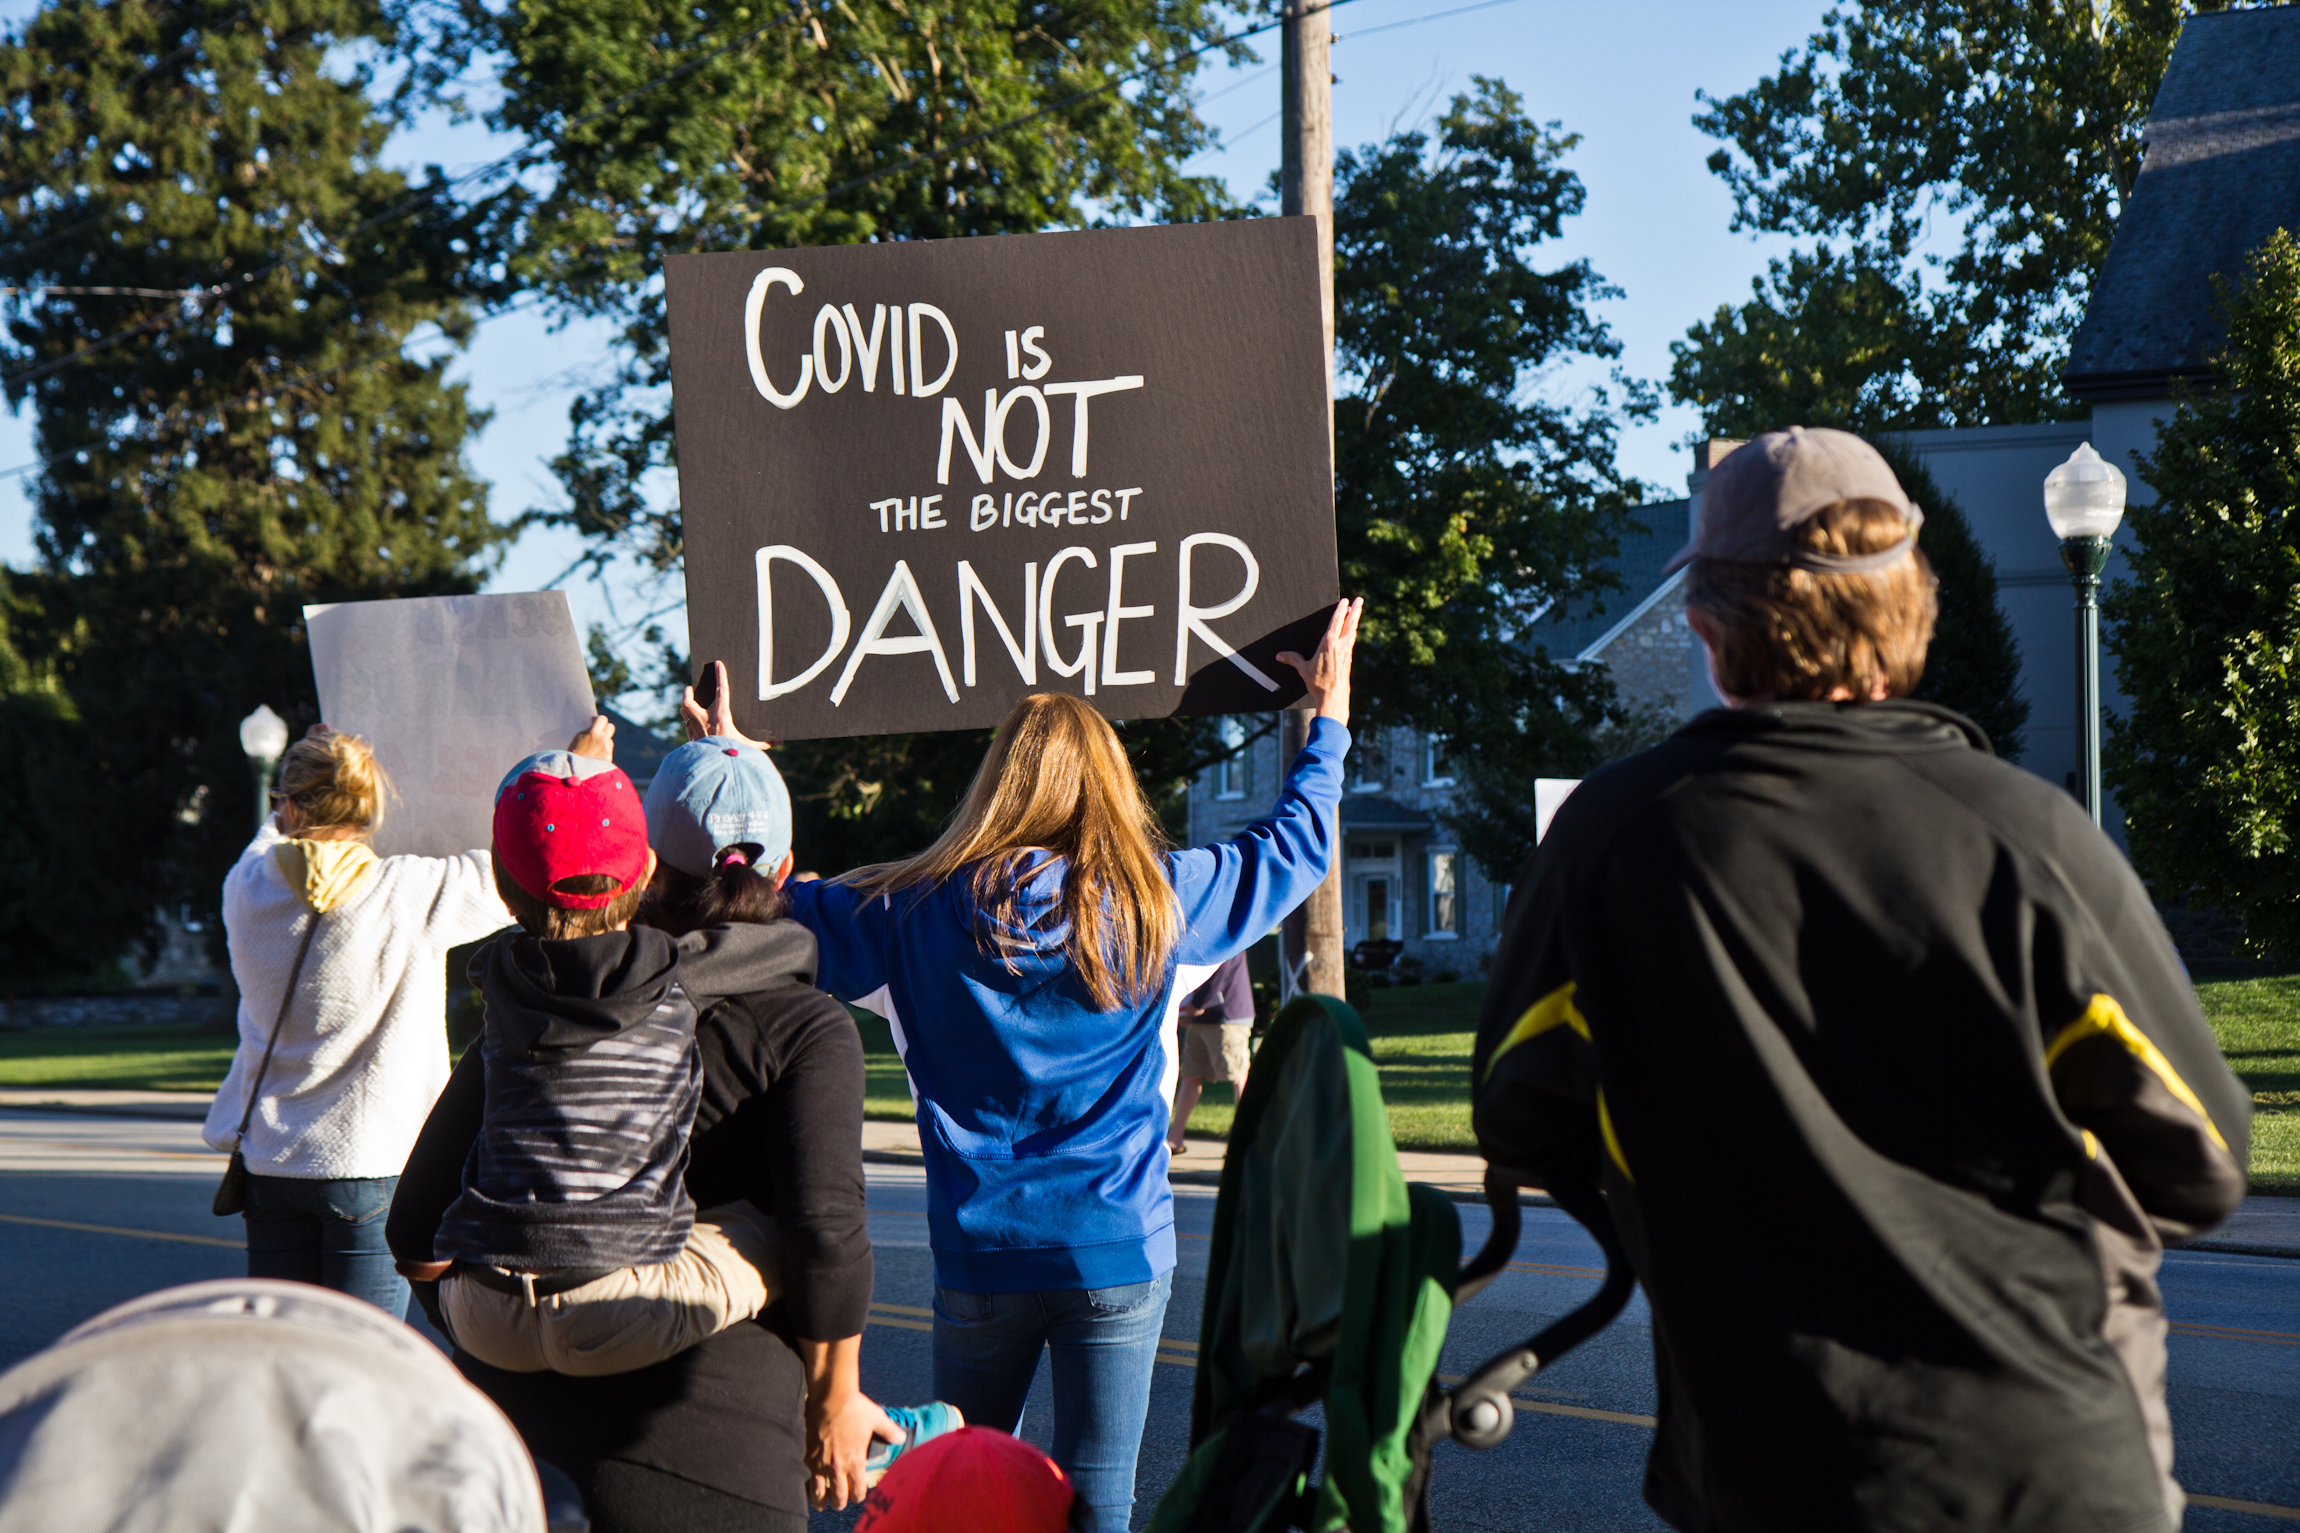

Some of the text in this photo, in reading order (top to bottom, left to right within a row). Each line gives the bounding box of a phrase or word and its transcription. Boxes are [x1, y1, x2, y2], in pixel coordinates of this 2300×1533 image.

[744, 266, 1053, 409] COVID IS
[937, 374, 1145, 486] NOT
[869, 486, 1144, 533] THE BIGGEST
[755, 531, 1281, 708] DANGER
